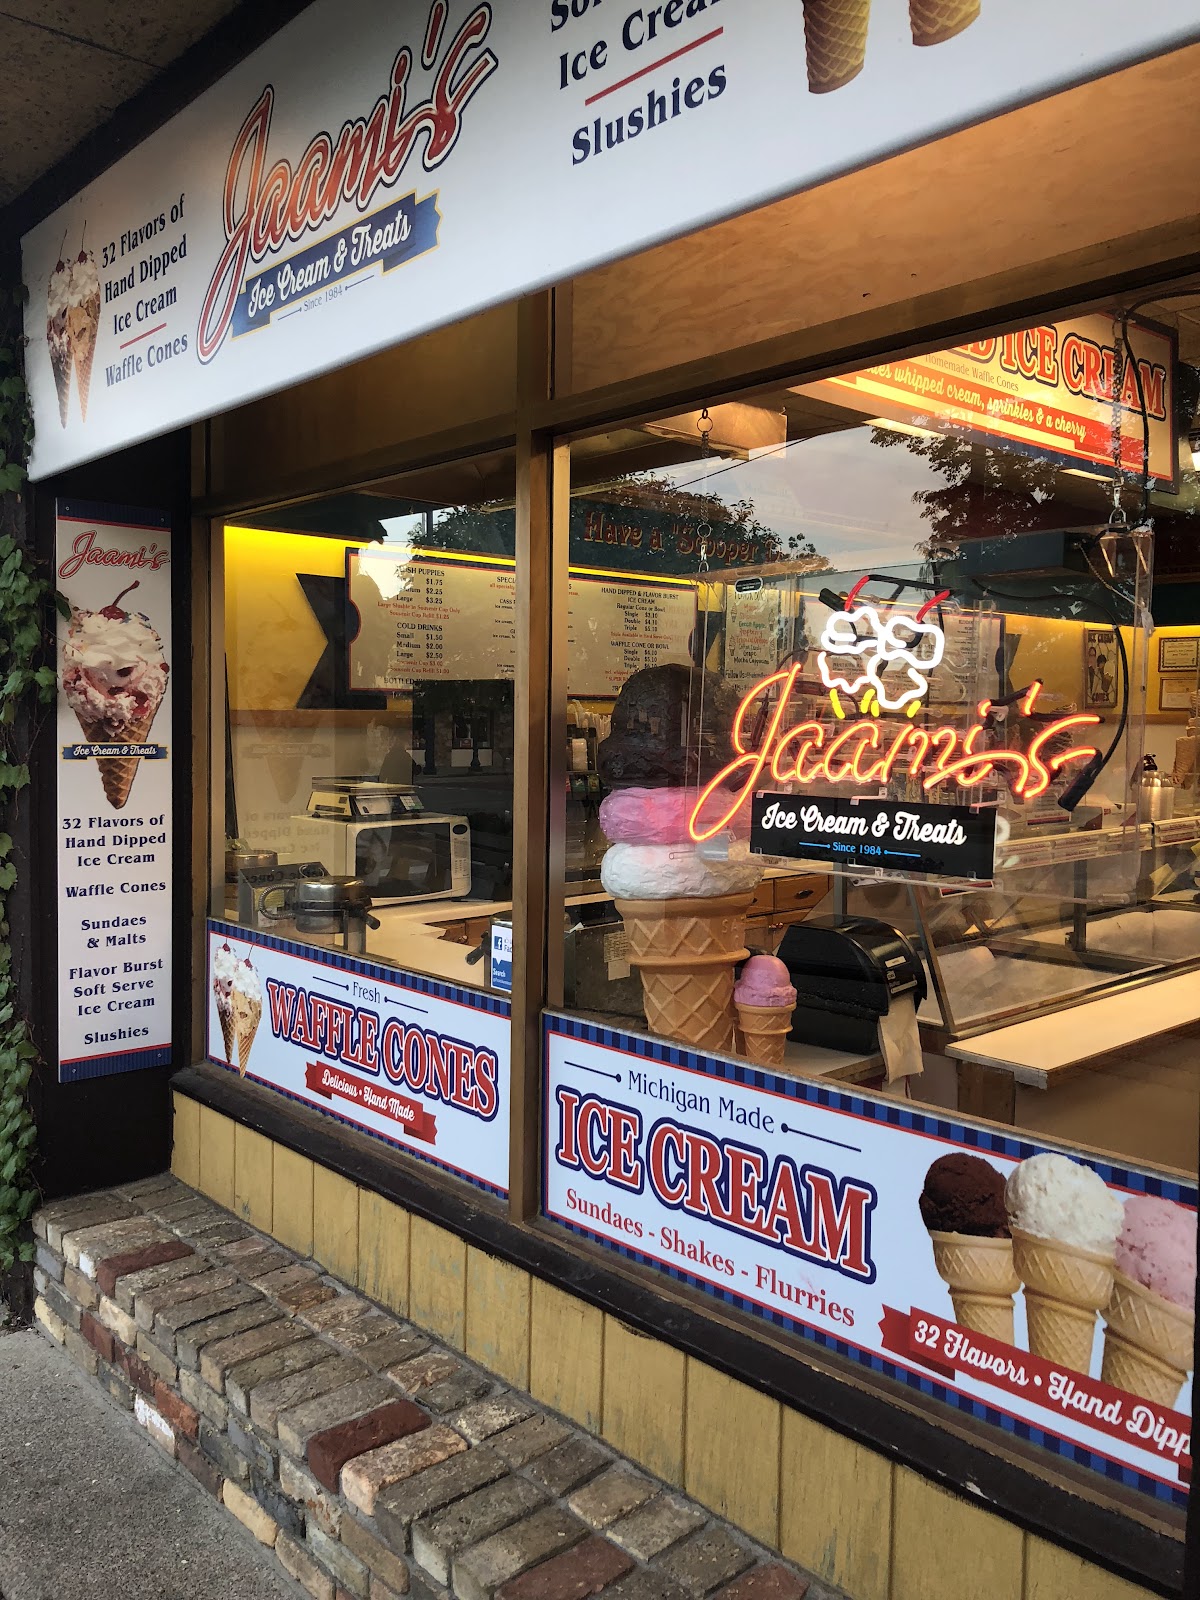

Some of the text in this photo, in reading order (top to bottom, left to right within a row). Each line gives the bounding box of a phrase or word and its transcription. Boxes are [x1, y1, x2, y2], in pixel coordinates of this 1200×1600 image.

[551, 0, 600, 33] So
[560, 0, 721, 90] Ice Crea
[572, 64, 727, 166] Slushies
[197, 0, 498, 364] Jaami's
[102, 193, 185, 269] 32 Flavors of
[104, 233, 188, 304] Hand Dipped
[248, 209, 412, 318] Ice Cream & Treats
[113, 286, 178, 335] Ice Cream
[303, 285, 343, 312] Since 1984
[105, 333, 188, 388] Waffle Cones
[1001, 326, 1058, 387] ICE
[972, 367, 994, 385] Waffle
[996, 375, 1019, 392] Cones
[894, 364, 945, 396] whipped
[947, 384, 985, 411] cream,
[986, 396, 1035, 423] sprinkles
[1036, 407, 1044, 423] &
[1046, 417, 1054, 428] a
[1054, 416, 1087, 443] cherry
[584, 511, 643, 549] Have
[650, 526, 664, 552] a
[58, 530, 171, 579] Jaami's
[418, 568, 445, 577] PUPPIES
[426, 578, 443, 586] $1.75
[396, 594, 413, 602] Large
[618, 588, 637, 596] DIPPED
[397, 622, 443, 631] COLD DRINKS
[396, 641, 421, 649] Medium
[396, 650, 413, 658] Large
[73, 745, 157, 756] Ice Cream & Treats
[689, 663, 1101, 841] Jaami's
[62, 814, 165, 829] 32 Flavors of
[761, 802, 967, 846] Ice Cream & Treats
[65, 832, 166, 849] Hand Dipped
[832, 842, 881, 856] Since 1984
[77, 853, 155, 867] Ice Cream
[65, 881, 166, 898] Waffle Cones
[81, 916, 147, 931] Sundaes
[87, 933, 147, 949] & Malts
[69, 958, 163, 980] Flavor Burst
[73, 979, 154, 998] Soft Serve
[353, 980, 381, 1004] Fresh
[78, 997, 155, 1016] Ice Cream
[84, 1026, 149, 1045] Slushies
[267, 978, 499, 1122] WAFFLE CONES
[321, 1068, 416, 1122] Delicious Hand Made
[628, 1070, 775, 1134] Michigan Made
[556, 1084, 877, 1285] ICE CREAM
[566, 1187, 855, 1327] Sundaes Shakes Flurries
[914, 1320, 940, 1349] 32
[944, 1328, 1030, 1388] Flavors
[1048, 1370, 1124, 1426] Hand
